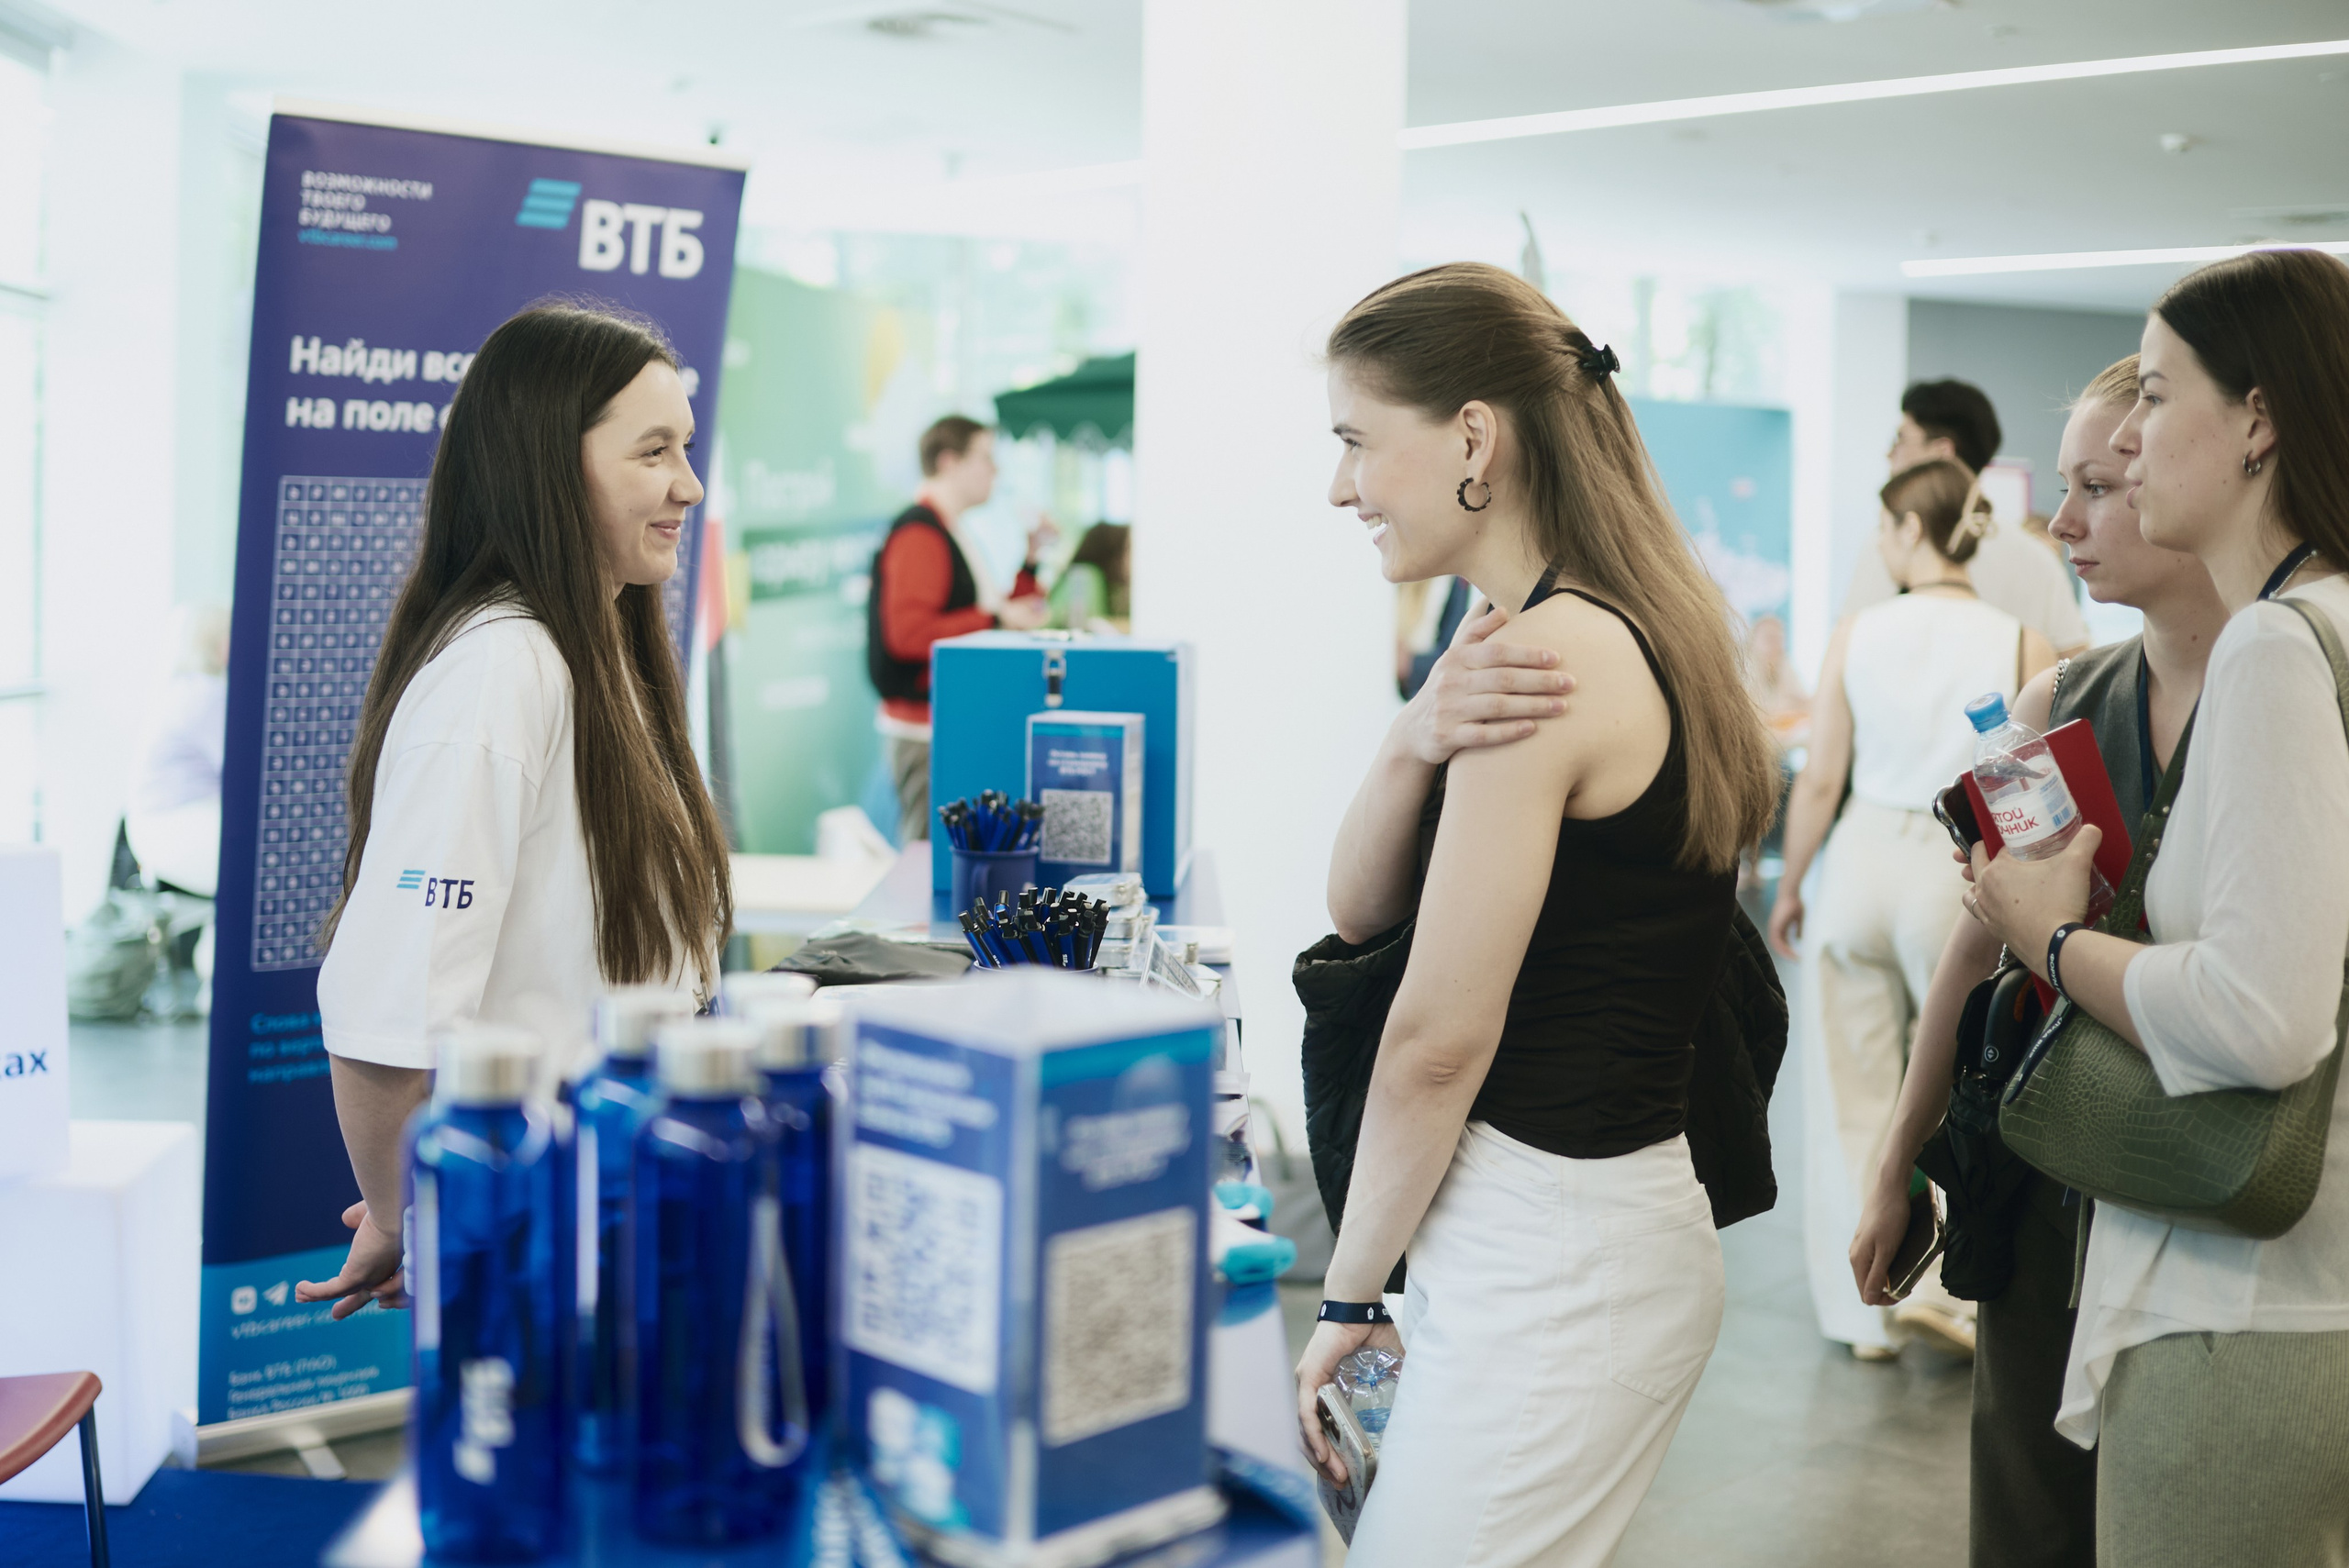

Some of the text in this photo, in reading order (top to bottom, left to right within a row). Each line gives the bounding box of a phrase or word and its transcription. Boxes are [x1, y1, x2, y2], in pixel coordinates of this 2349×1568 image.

[300, 189, 366, 212] ТВОЕГО
[301, 170, 433, 201] ВОЗМОЖНОСТИ
[298, 207, 392, 233] БУДУЩЕГО
[578, 198, 705, 279] ВТБ
[289, 335, 417, 384] Найди
[285, 396, 336, 428] на
[342, 399, 435, 433] поле
[425, 877, 474, 909] ВТБ
[2050, 953, 2058, 986] ФОРУМ
